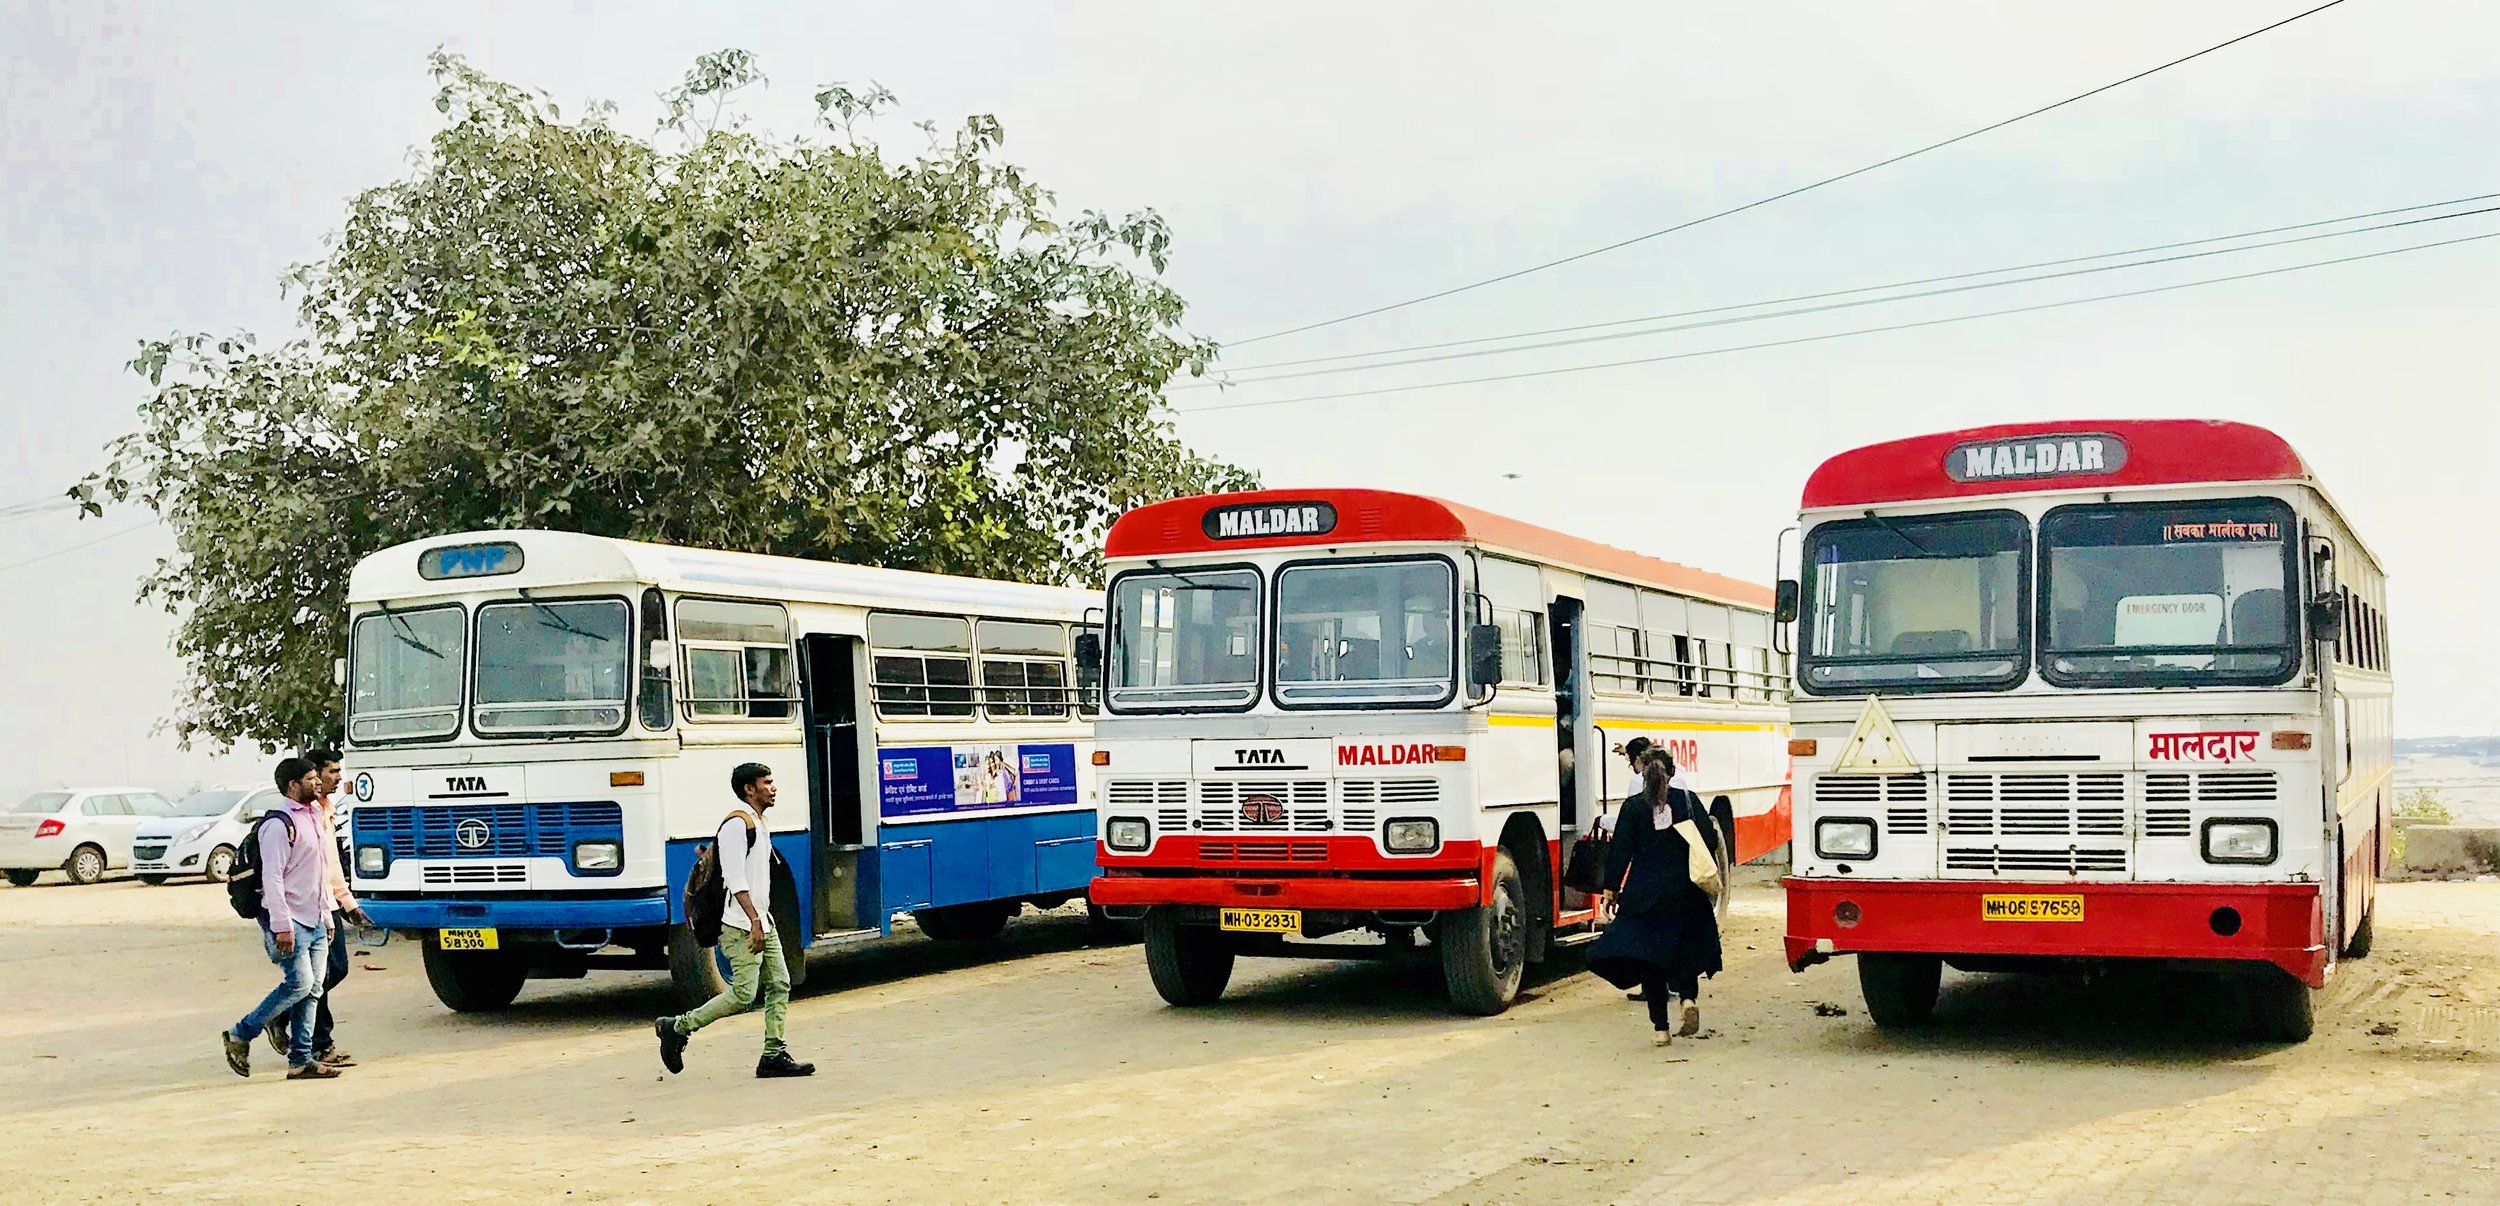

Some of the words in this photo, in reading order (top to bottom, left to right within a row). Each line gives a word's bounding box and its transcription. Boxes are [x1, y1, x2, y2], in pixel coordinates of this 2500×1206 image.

[1965, 439, 2105, 479] MALDAR
[1218, 505, 1320, 538] MALDAR
[440, 546, 505, 576] PNP
[2126, 603, 2180, 615] EMERGENCY
[2181, 602, 2207, 614] DOOR
[1234, 749, 1285, 765] TATA
[1337, 743, 1436, 767] MALDAR
[2148, 731, 2261, 765] मालदार
[358, 778, 368, 798] 3
[445, 776, 488, 792] TATA
